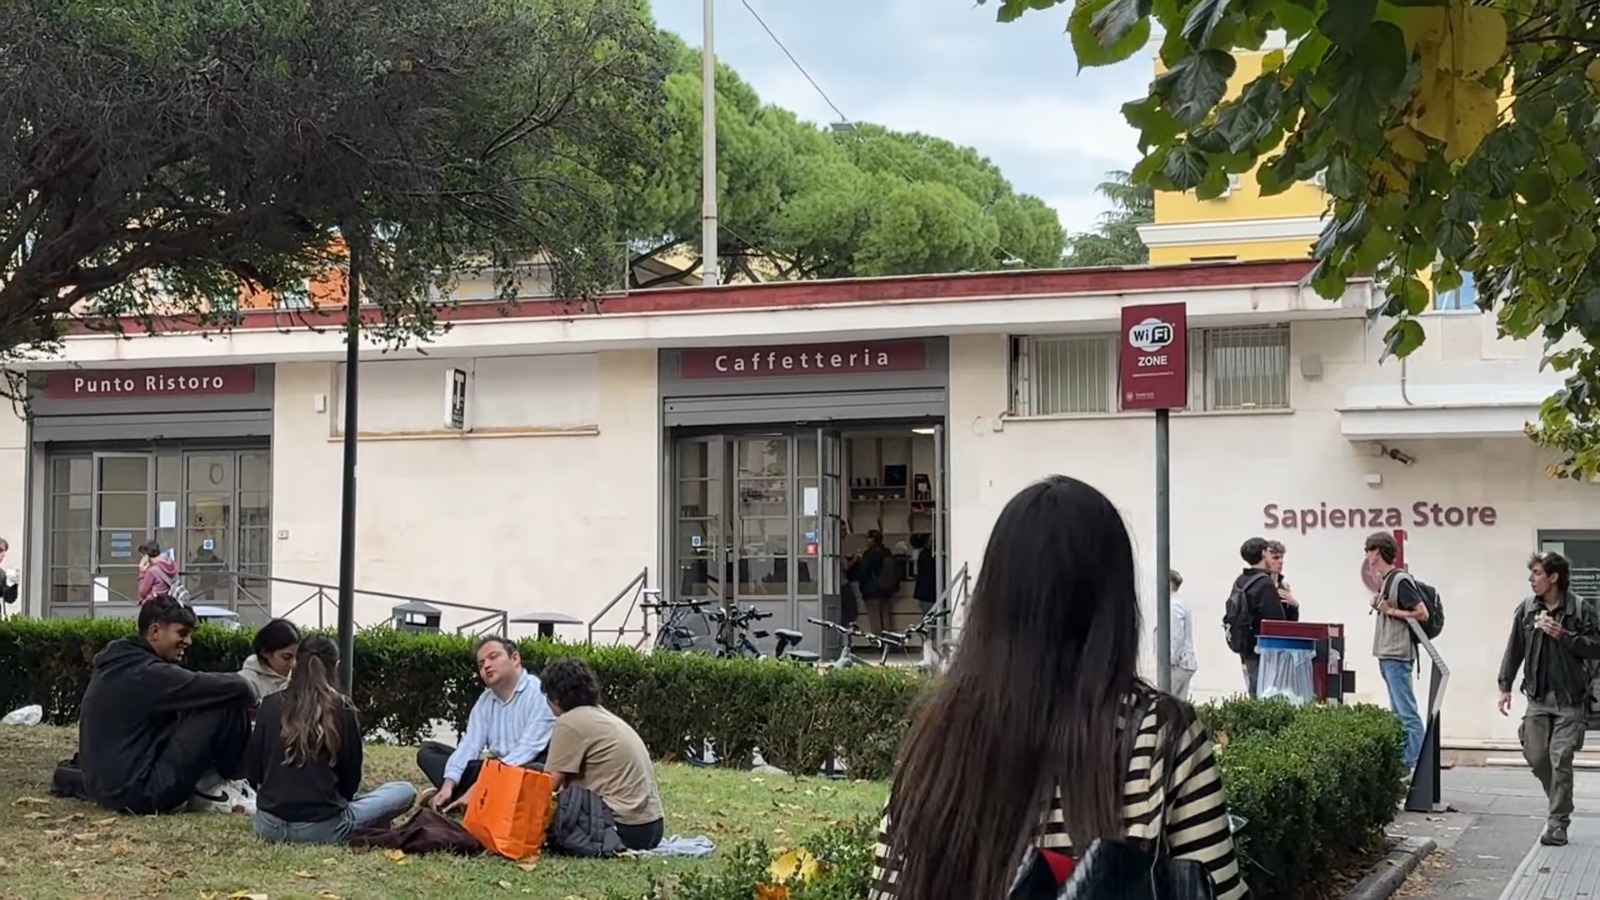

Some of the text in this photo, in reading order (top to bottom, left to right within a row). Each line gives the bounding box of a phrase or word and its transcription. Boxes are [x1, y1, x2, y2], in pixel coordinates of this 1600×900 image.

[715, 348, 888, 372] Caffetteria
[1138, 355, 1168, 367] ZONE
[75, 375, 224, 393] Punto Ristoro
[1263, 501, 1497, 535] Sapienza Store
